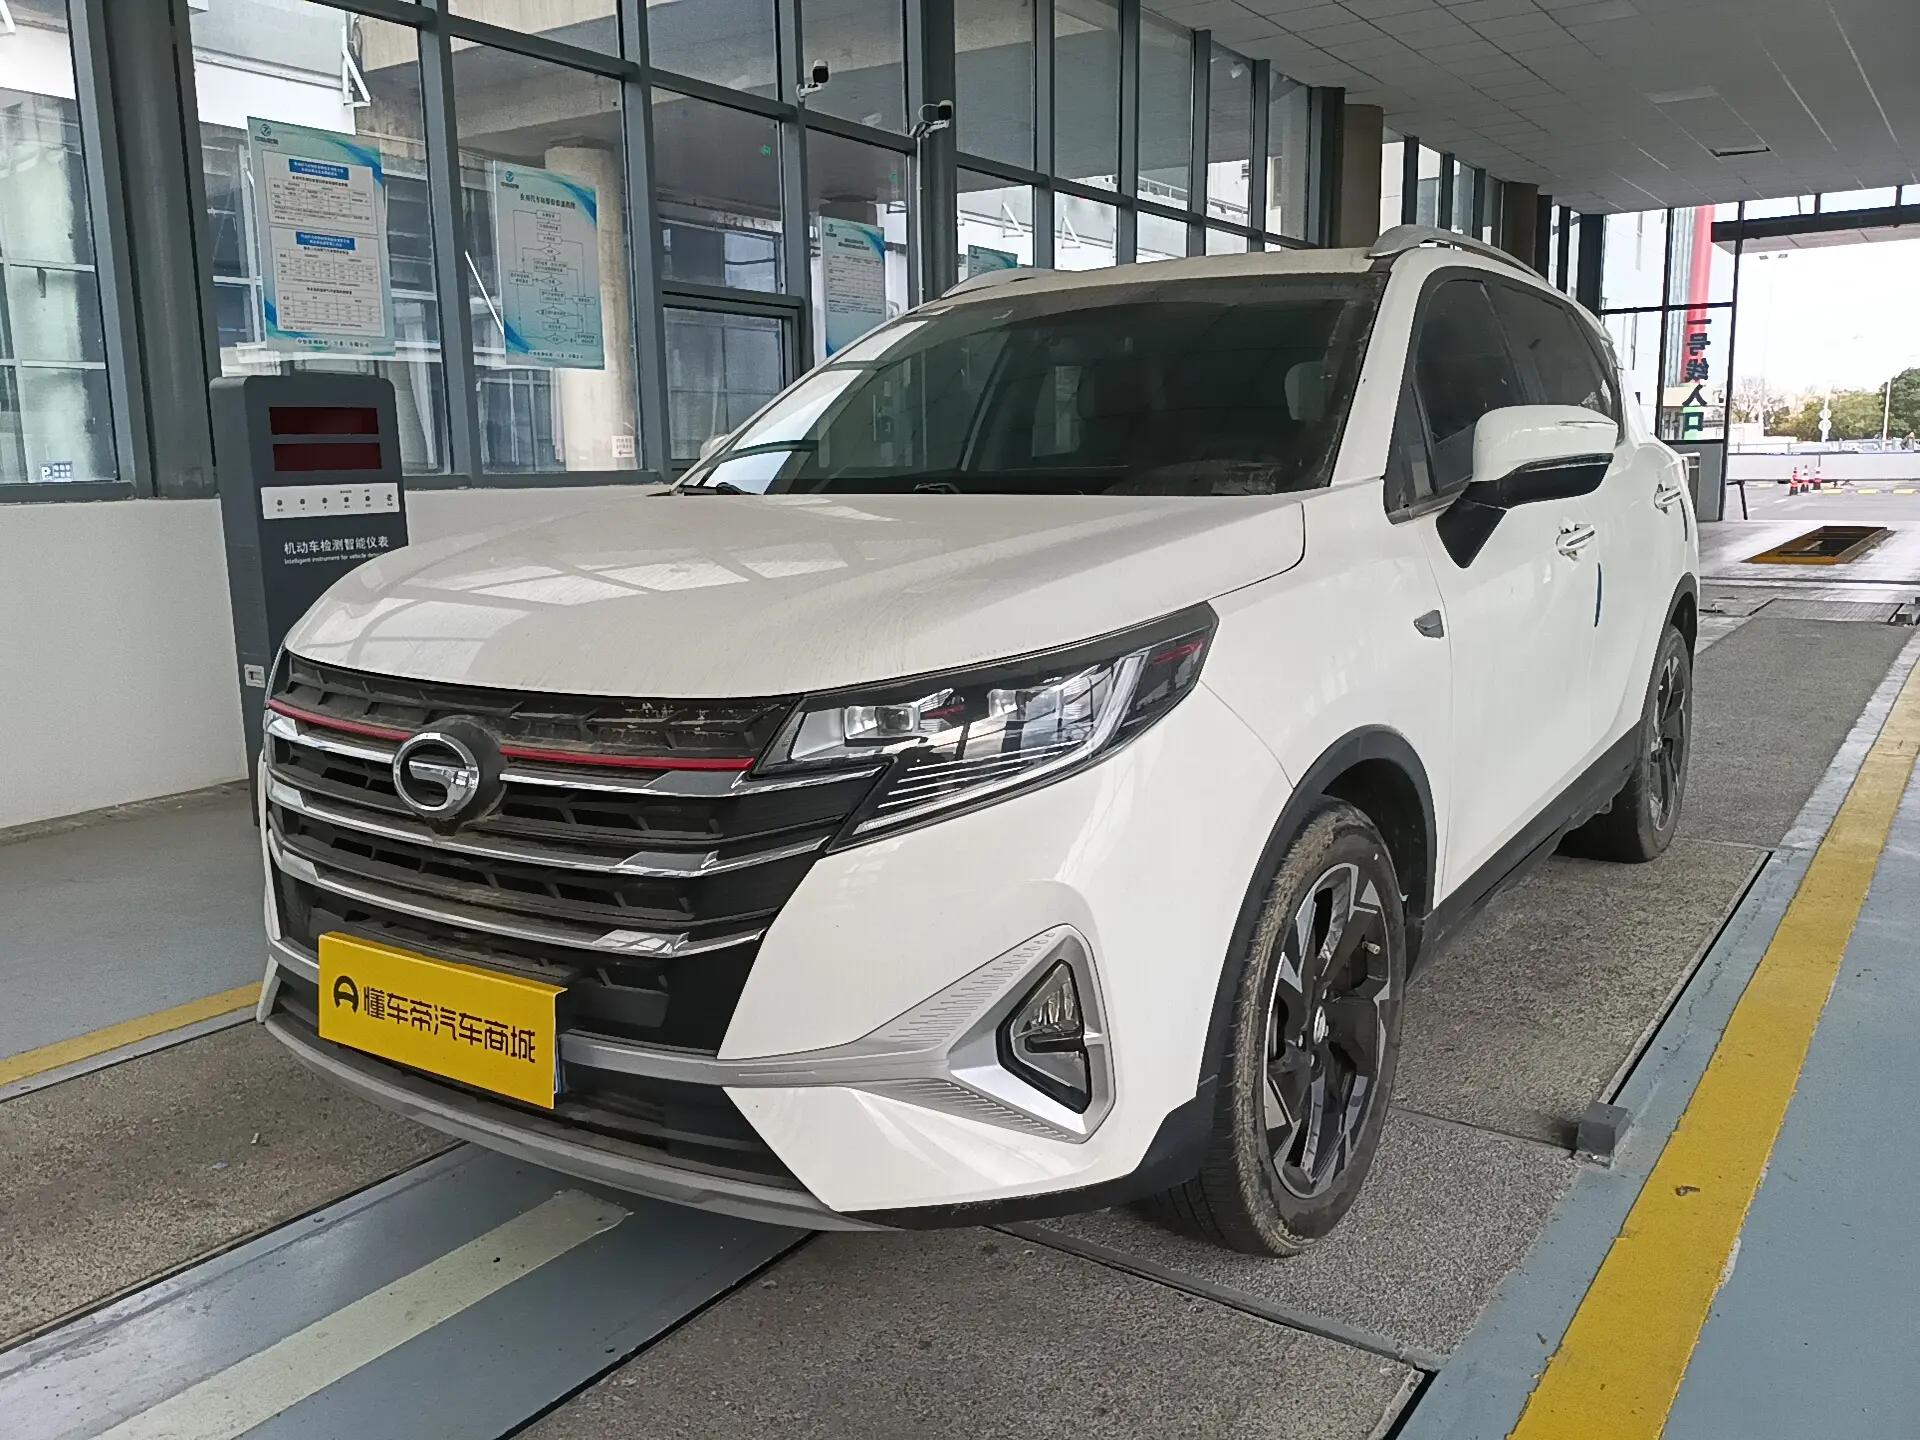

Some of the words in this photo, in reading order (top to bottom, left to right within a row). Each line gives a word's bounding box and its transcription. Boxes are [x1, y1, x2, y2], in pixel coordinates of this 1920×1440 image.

[284, 535, 389, 555] 机动车检测智能仪表
[363, 985, 536, 1063] 懂车帝汽车商城
